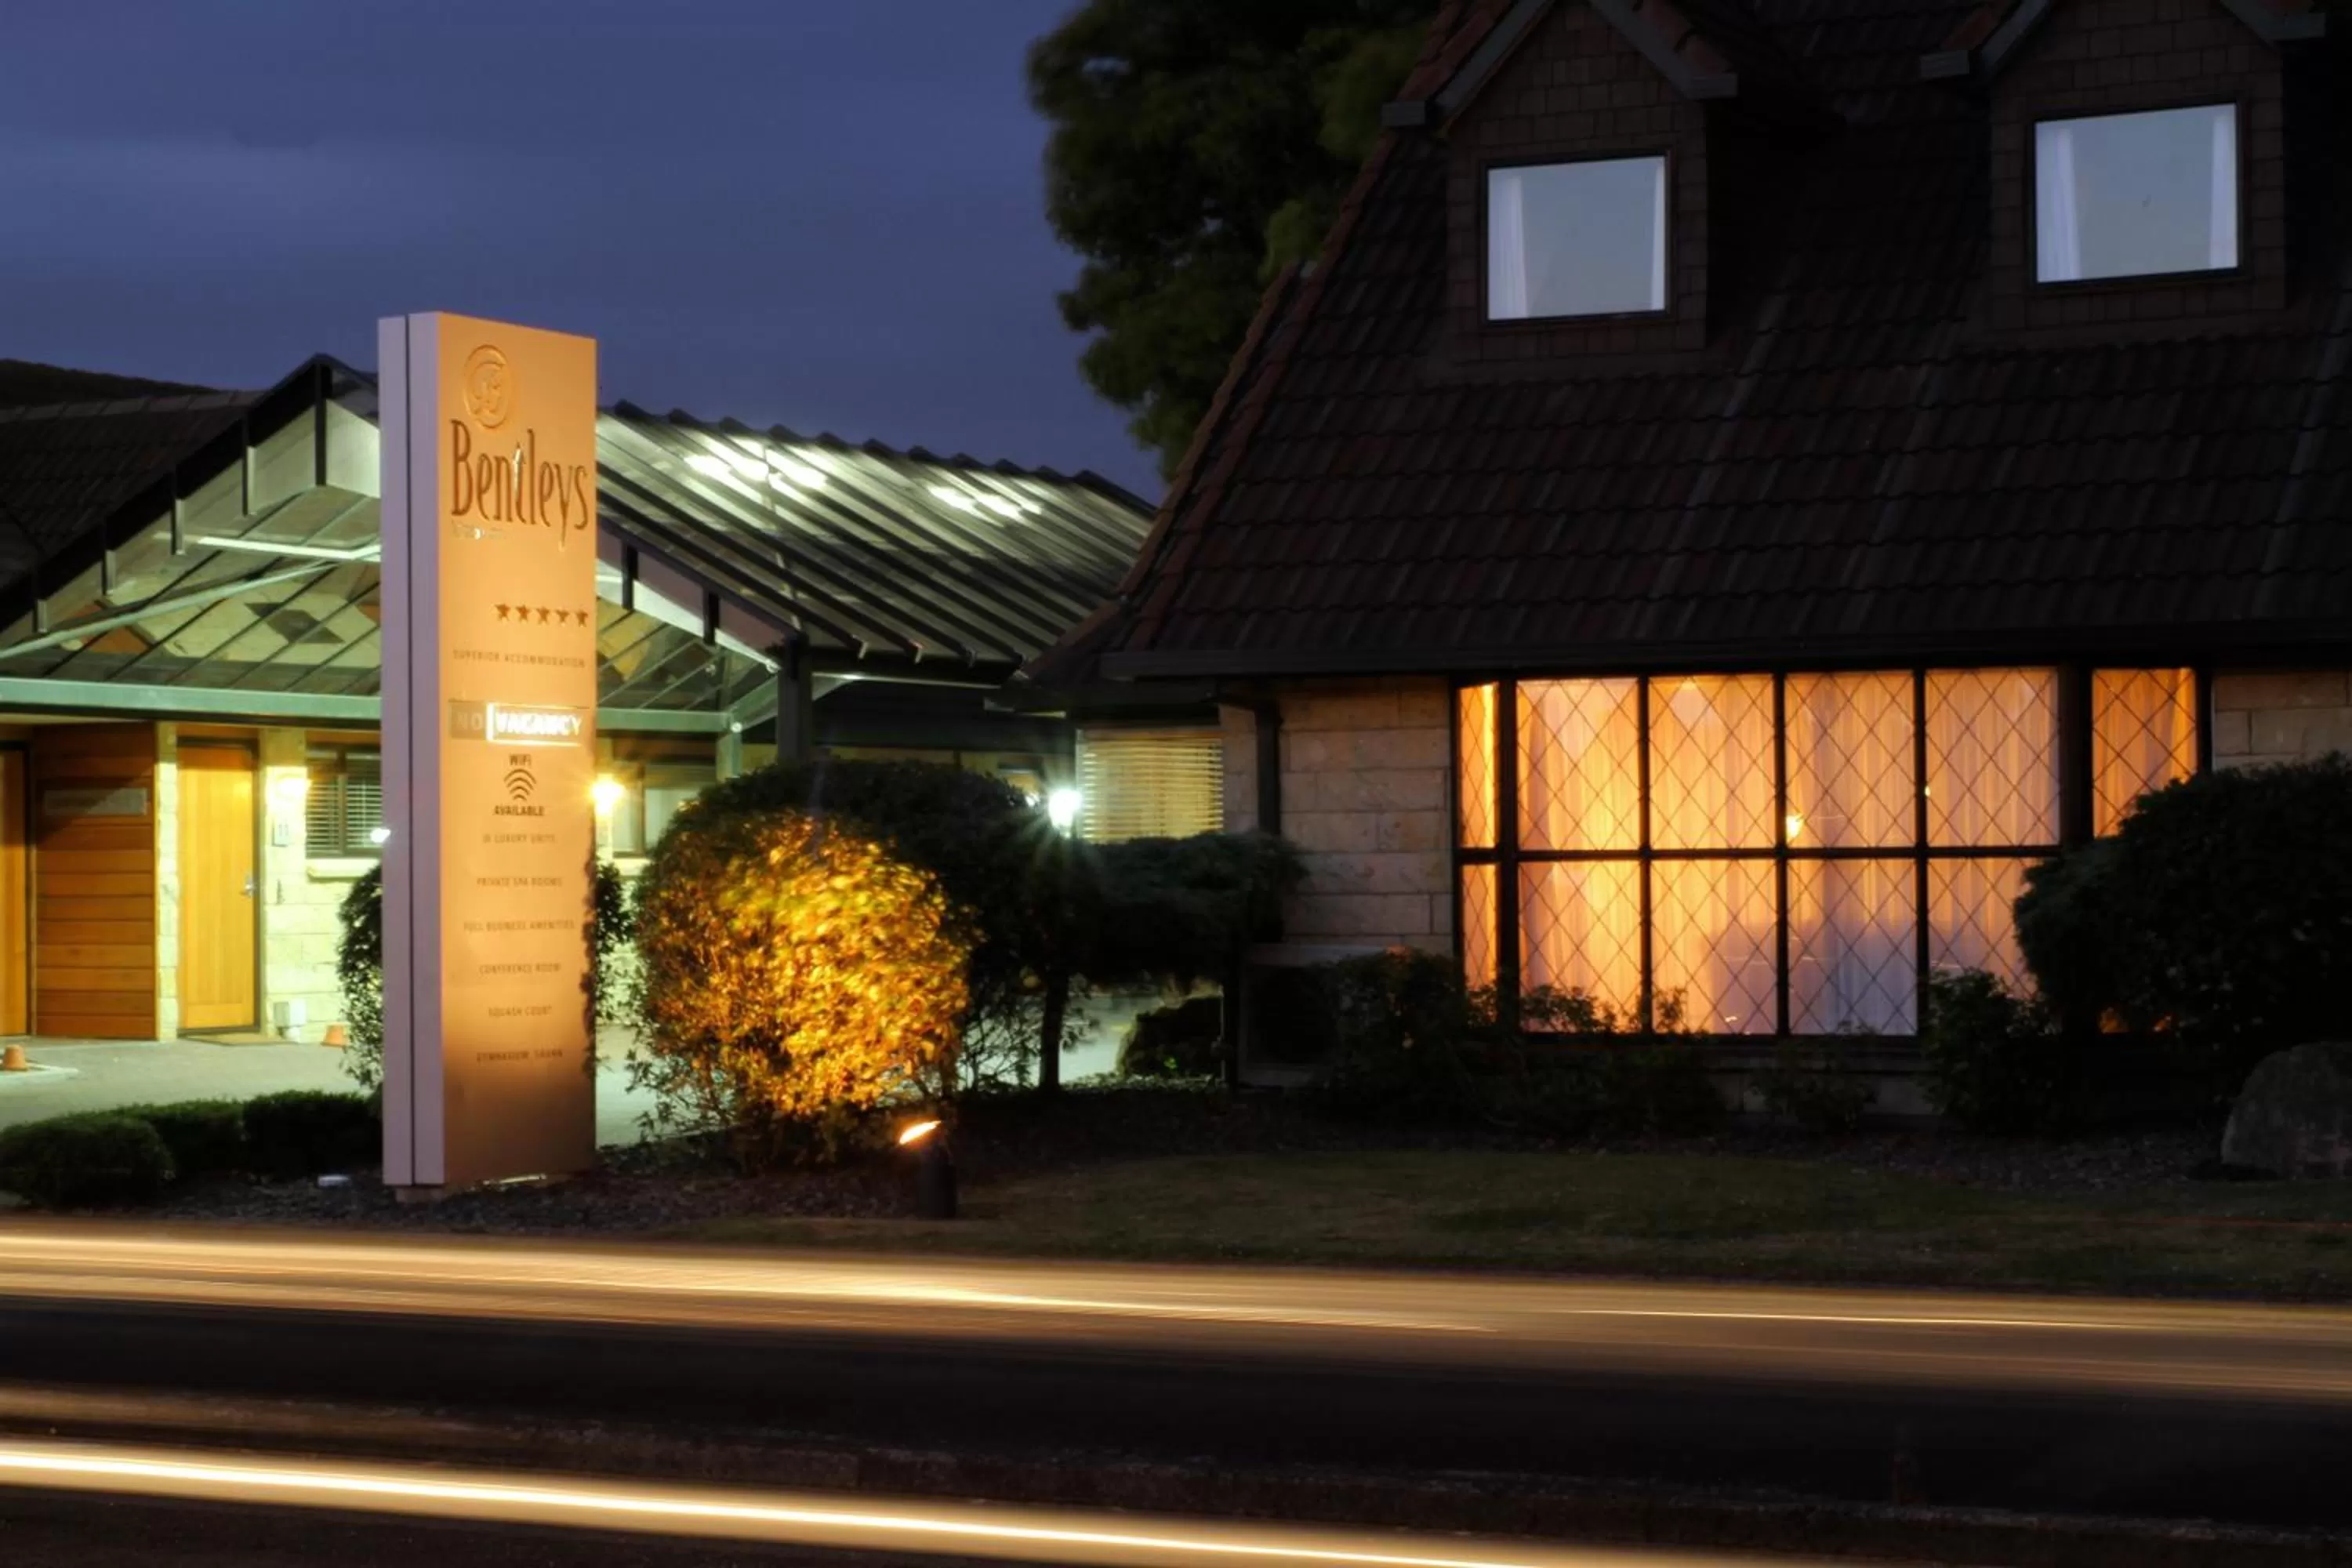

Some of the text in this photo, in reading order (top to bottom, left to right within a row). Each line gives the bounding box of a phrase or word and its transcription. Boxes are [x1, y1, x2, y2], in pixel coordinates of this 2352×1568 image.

[450, 419, 588, 547] Bentleys
[457, 712, 583, 735] NO VACANCY
[492, 805, 545, 816] AVAILABLE
[494, 833, 528, 843] LUXURY
[476, 877, 510, 887] PRIVATE
[532, 877, 563, 887] ROOMS
